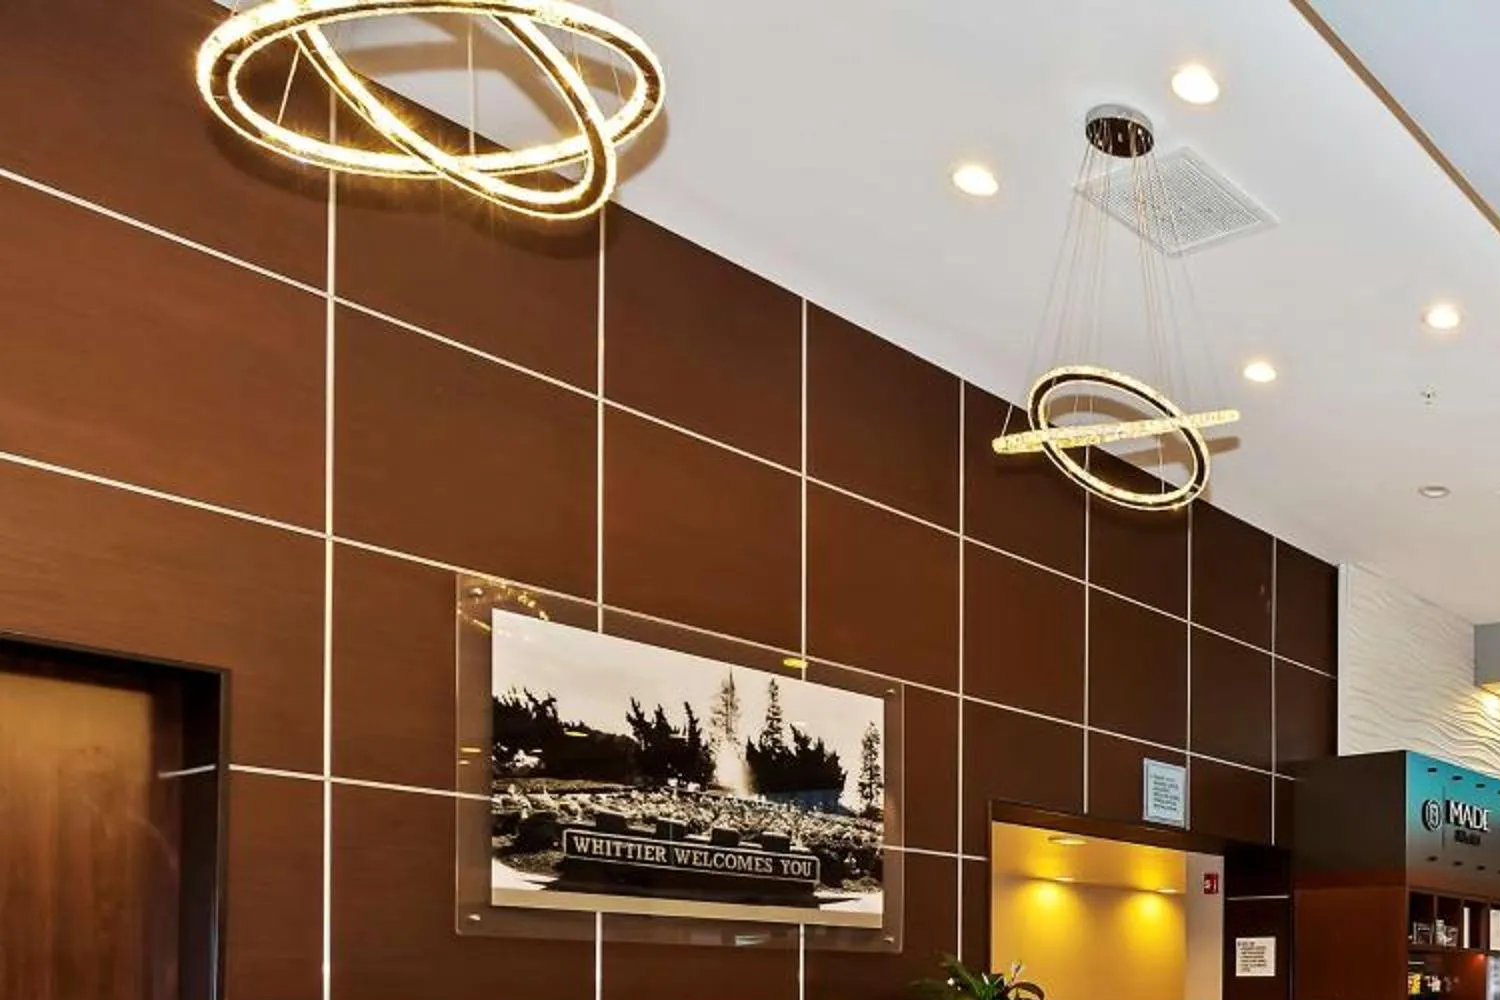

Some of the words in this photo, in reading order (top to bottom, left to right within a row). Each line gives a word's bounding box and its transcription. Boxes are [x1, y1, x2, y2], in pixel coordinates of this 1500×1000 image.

[1449, 799, 1490, 831] MADE
[573, 835, 668, 864] WHITTIER
[672, 847, 774, 873] WELCOMES
[779, 859, 812, 877] YOU
